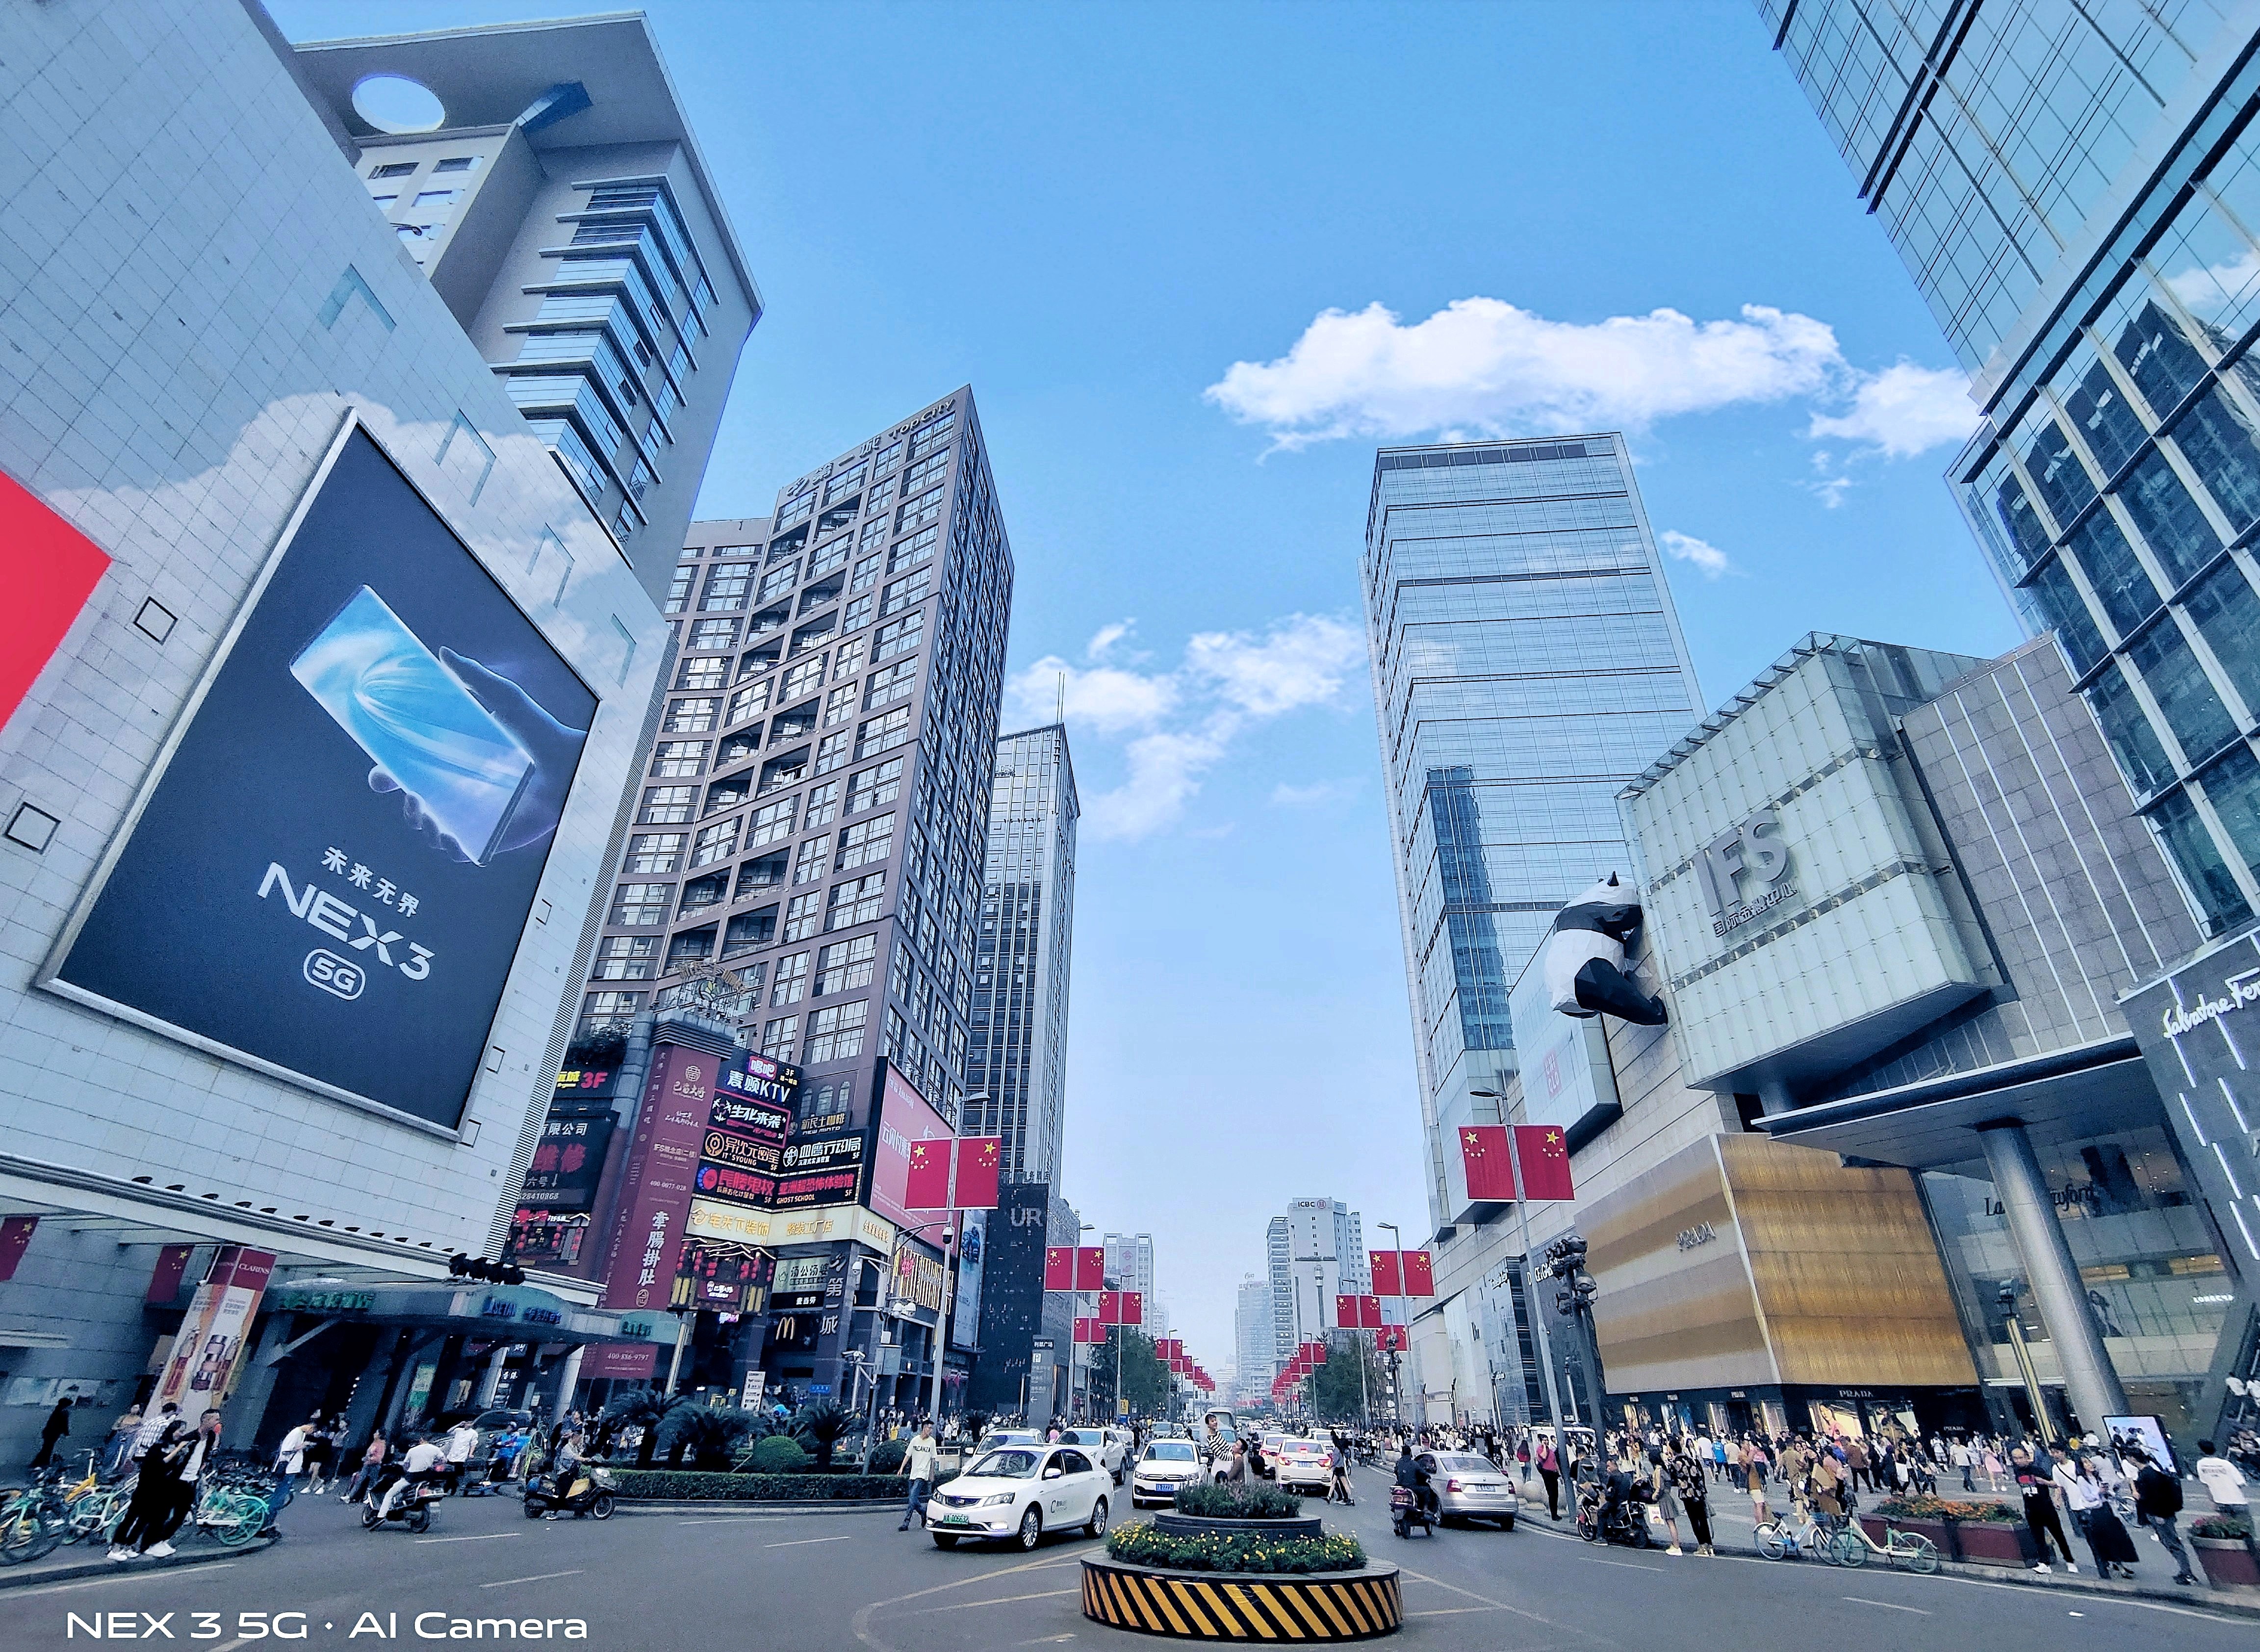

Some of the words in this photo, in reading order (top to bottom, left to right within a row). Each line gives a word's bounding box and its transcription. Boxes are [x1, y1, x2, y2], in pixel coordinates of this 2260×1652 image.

[1693, 809, 1788, 917] IFS
[321, 846, 420, 918] 未来无界
[257, 862, 404, 967] NEX
[399, 942, 435, 981] 3
[312, 956, 357, 993] 5G
[2163, 993, 2236, 1038] Salvatore
[751, 1059, 775, 1078] 唱吧
[785, 1068, 795, 1077] 3F
[581, 1071, 608, 1088] 3F
[727, 1070, 791, 1102] 麦颂KTV
[729, 1105, 782, 1129] 生化来袭
[540, 1123, 588, 1136] 有限公司
[776, 1196, 794, 1204] GHOST
[794, 1193, 815, 1202] SCHOOL
[708, 1213, 770, 1237] 宅天下装饰
[1010, 1207, 1043, 1227] UR
[786, 1219, 833, 1237] 整装工厂店
[238, 1263, 270, 1274] CLARINS
[607, 1352, 649, 1361] 400-886-9797
[1839, 1390, 1874, 1398] PRADA
